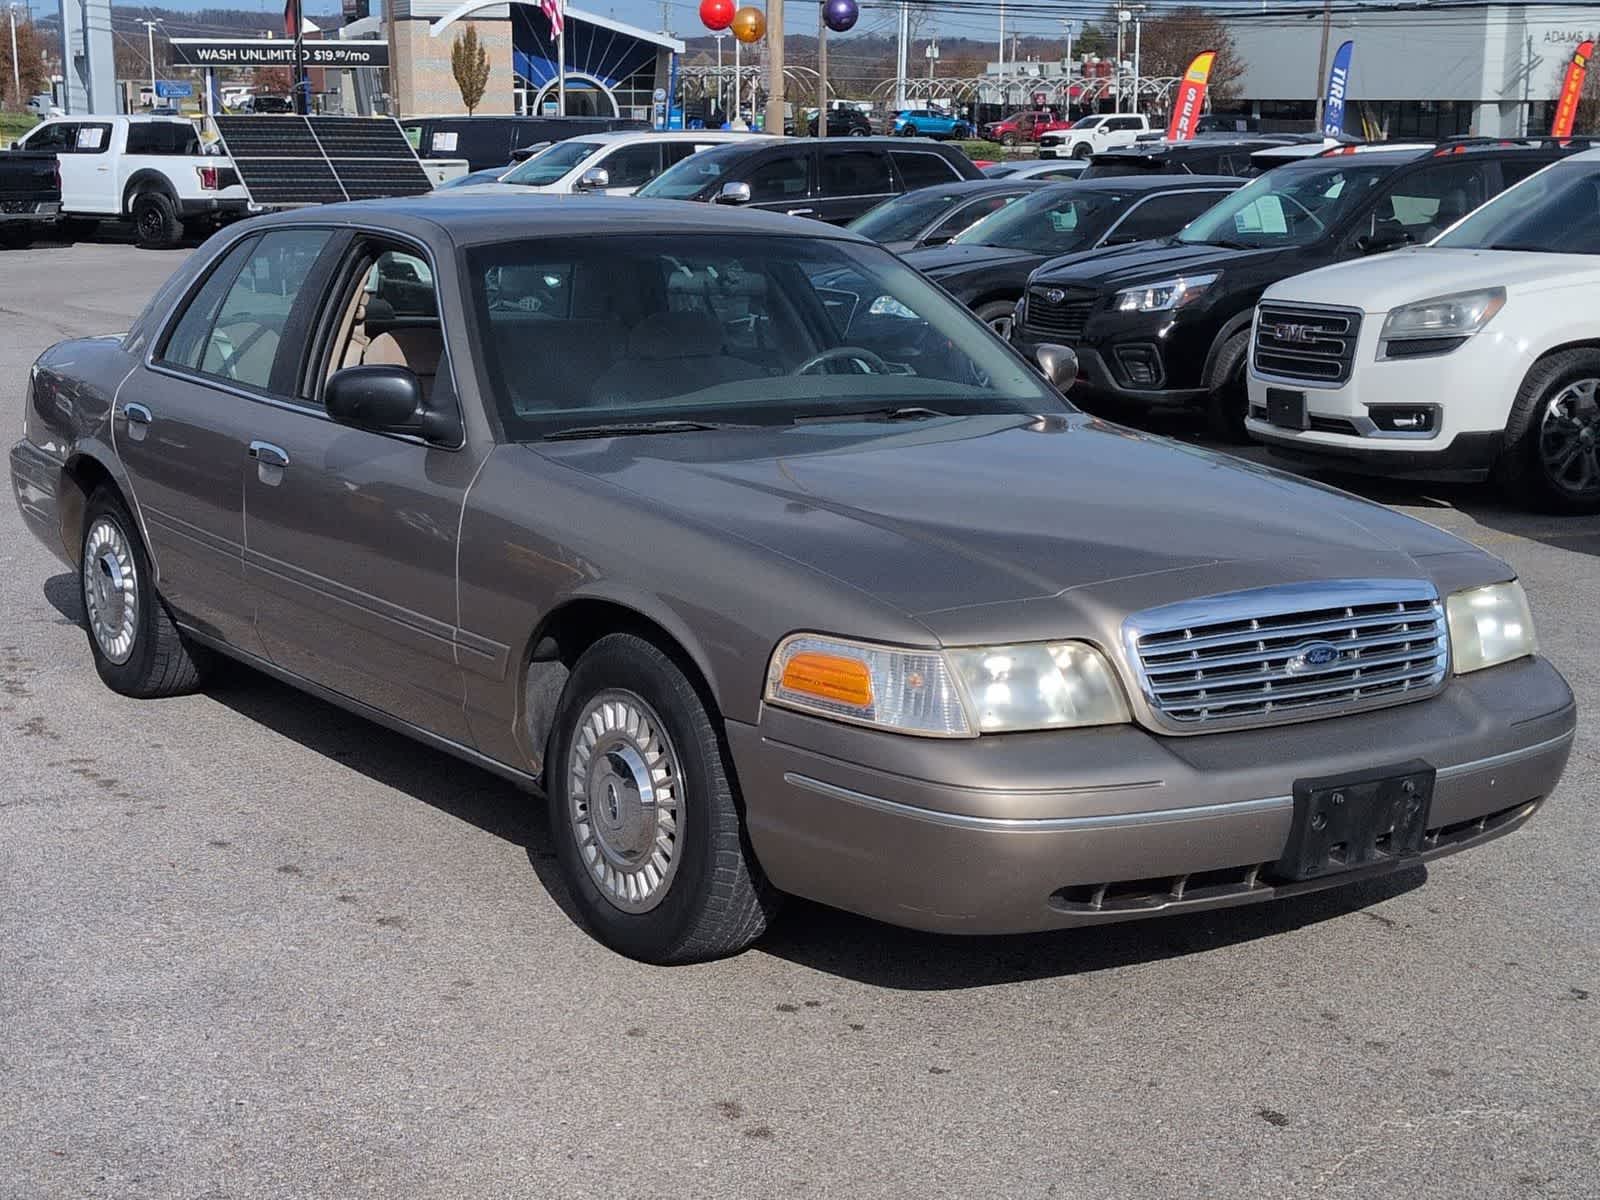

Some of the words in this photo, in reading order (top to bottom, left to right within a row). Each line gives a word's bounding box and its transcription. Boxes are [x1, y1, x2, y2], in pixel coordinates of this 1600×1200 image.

[1543, 31, 1584, 43] ADAMS
[197, 49, 237, 61] WASH
[313, 50, 370, 61] $19.99/mo
[1329, 67, 1346, 110] TIRE
[1274, 323, 1322, 344] GMC
